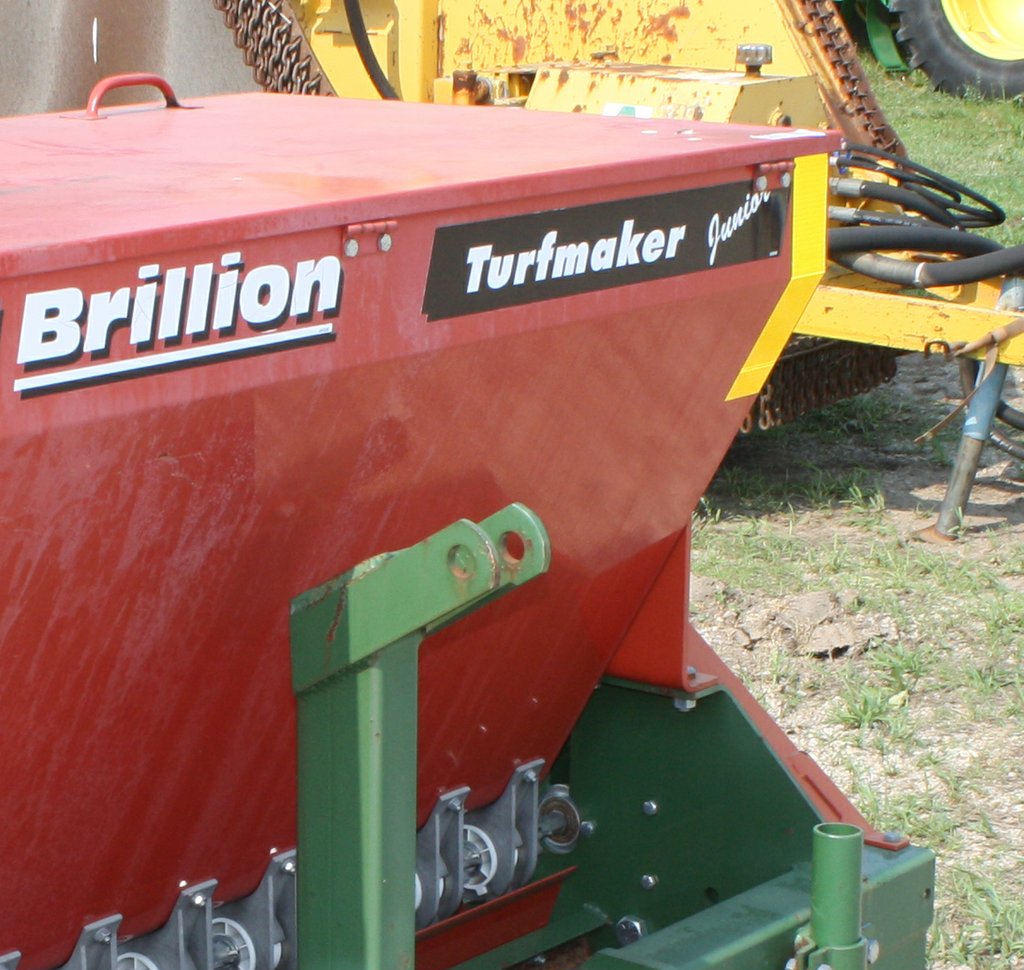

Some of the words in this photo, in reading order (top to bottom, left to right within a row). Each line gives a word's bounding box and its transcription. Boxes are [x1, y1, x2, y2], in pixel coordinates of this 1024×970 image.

[466, 219, 686, 293] Turfmaker
[708, 190, 771, 266] Junior
[17, 251, 343, 370] Brillion
